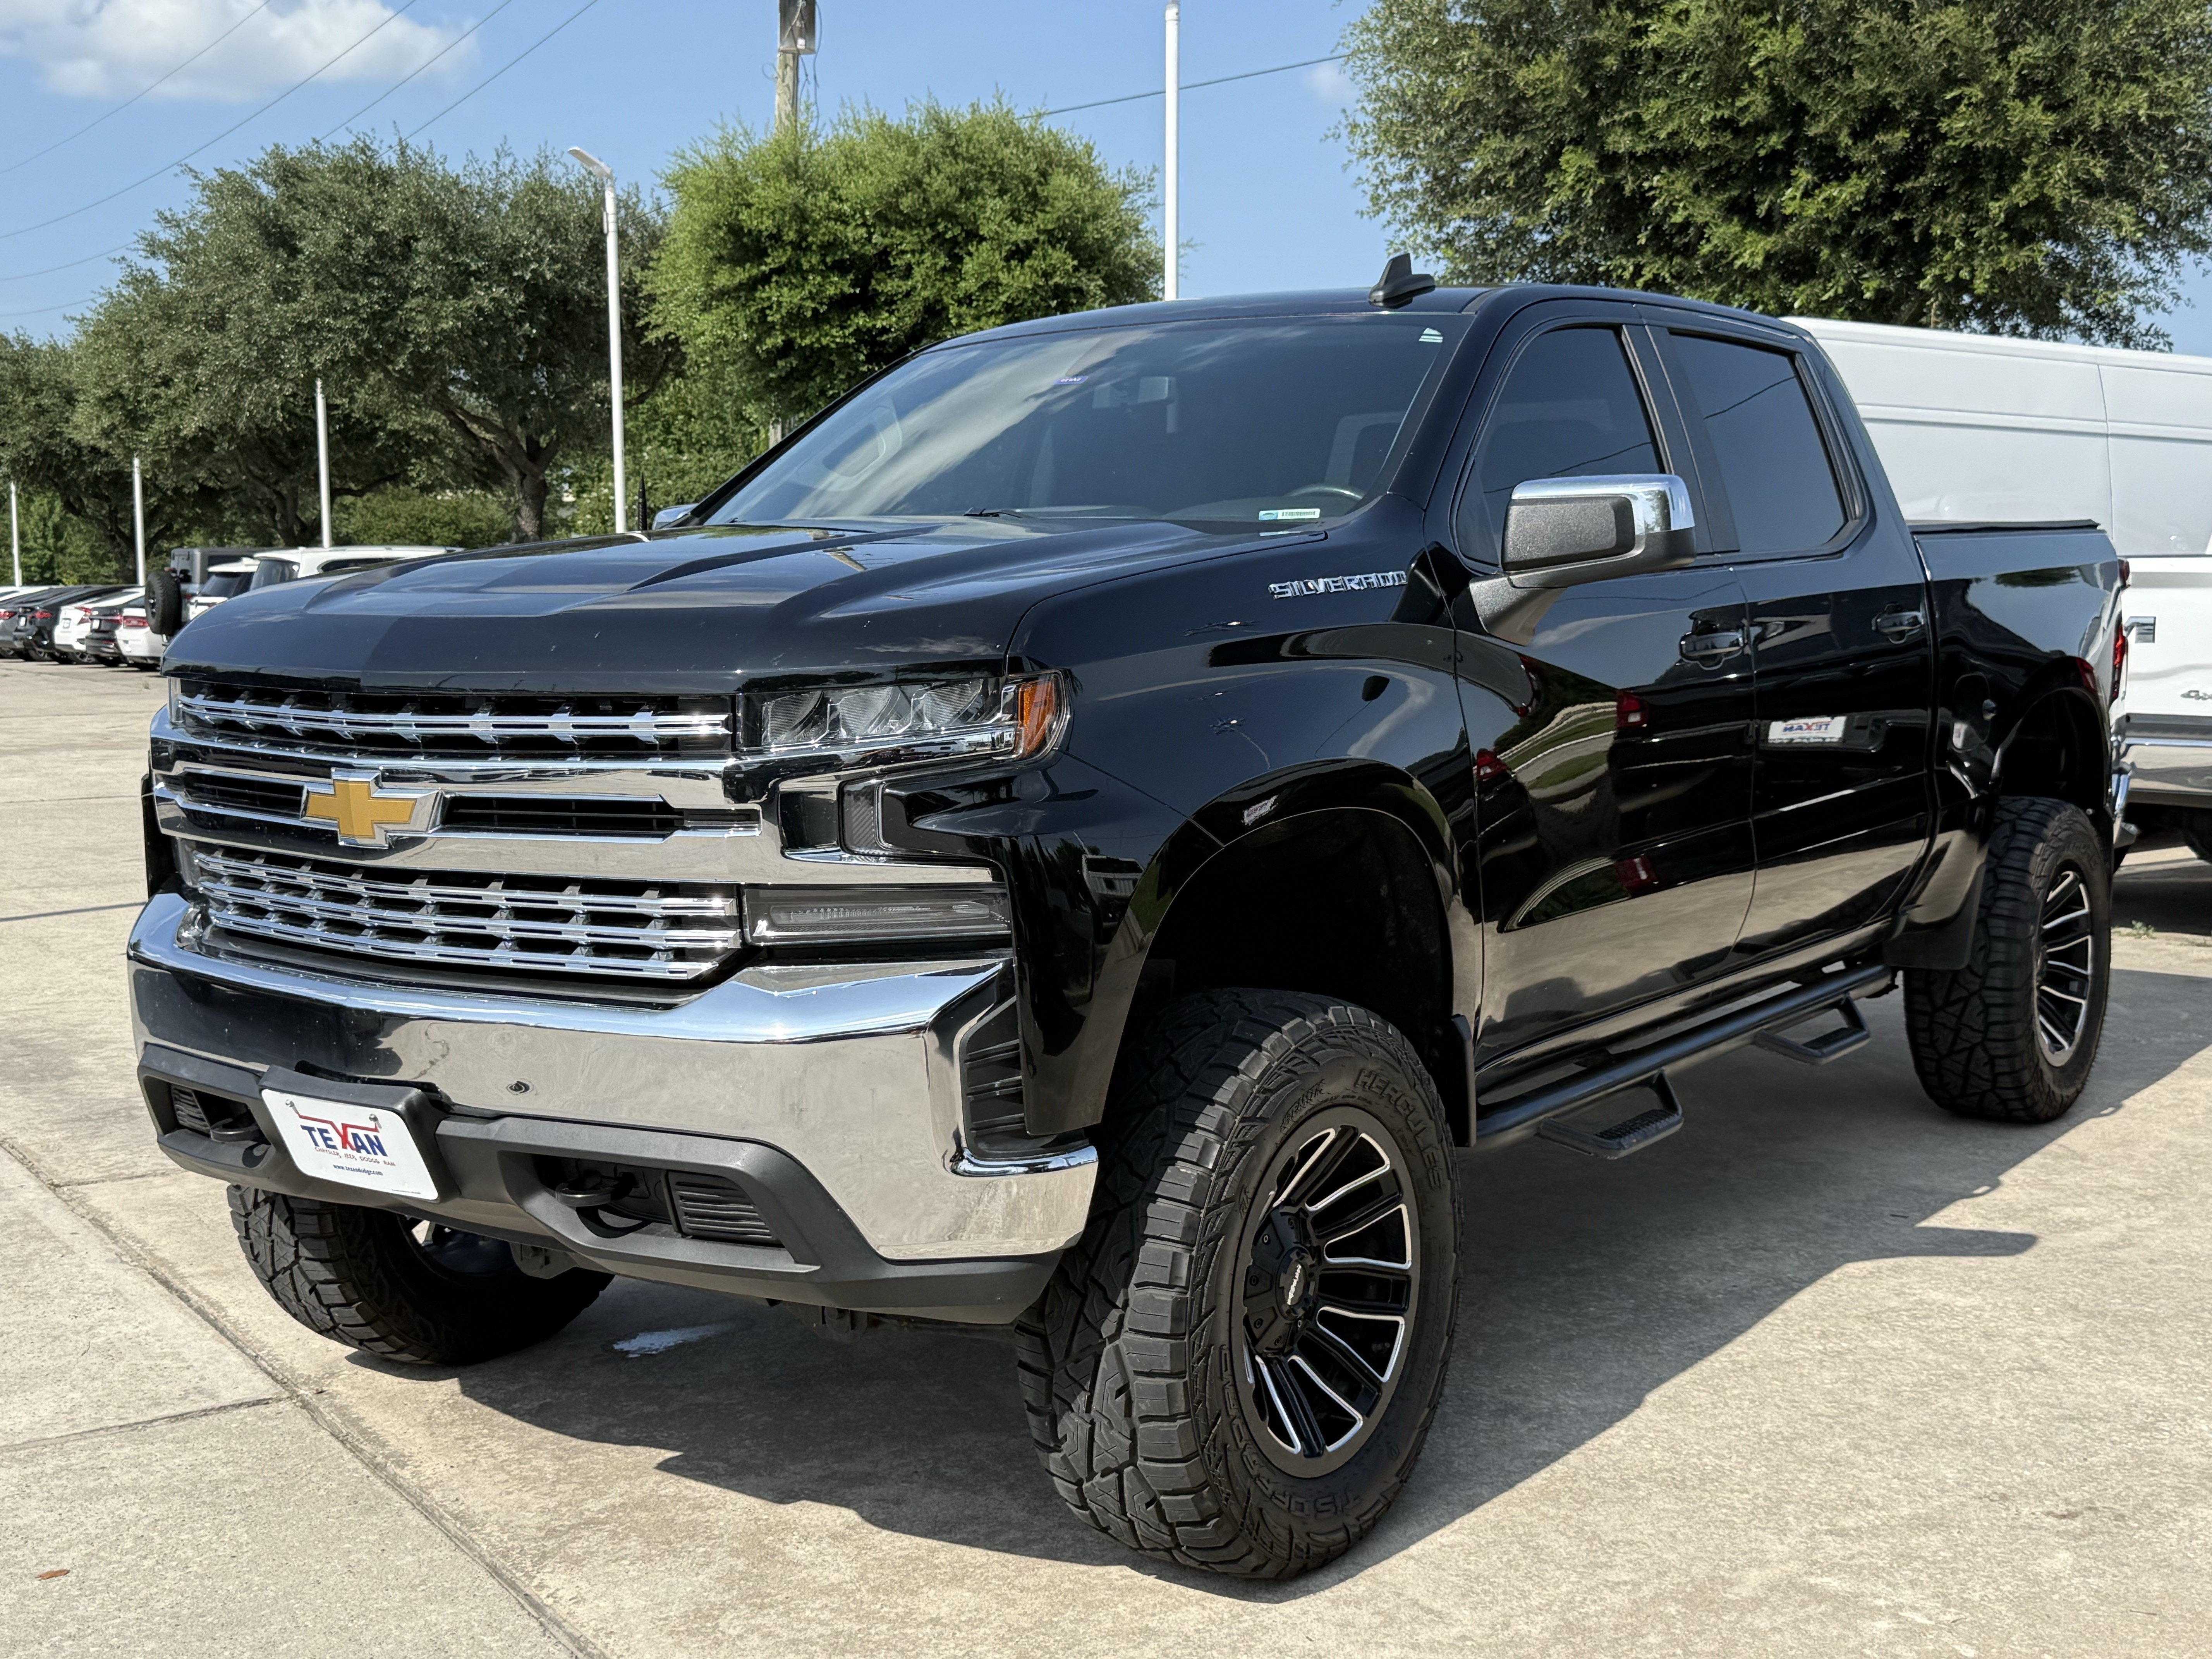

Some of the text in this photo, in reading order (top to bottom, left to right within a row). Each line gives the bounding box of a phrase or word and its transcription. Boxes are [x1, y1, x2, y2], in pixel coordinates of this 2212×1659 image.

[1268, 571, 1408, 599] SILVERADO
[301, 1123, 388, 1157] TEXAN
[1353, 1068, 1442, 1191] HERCULES
